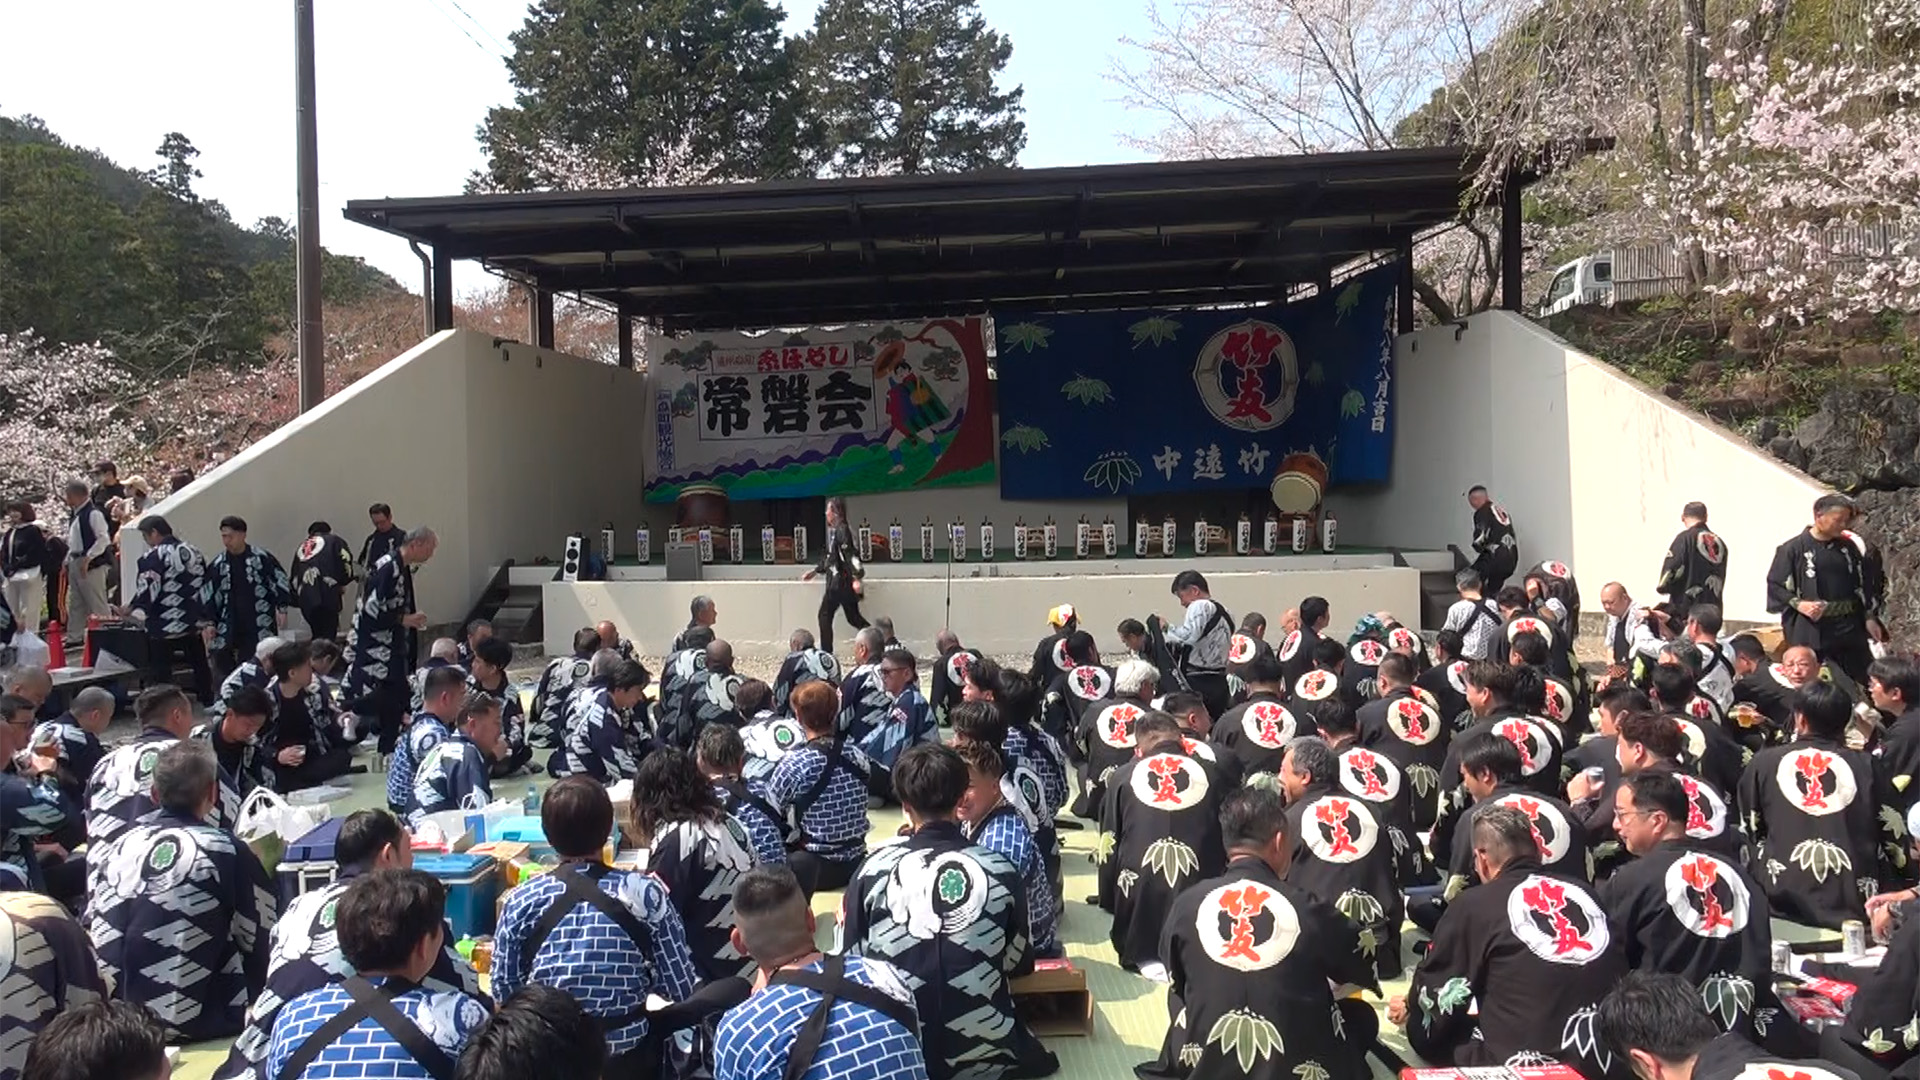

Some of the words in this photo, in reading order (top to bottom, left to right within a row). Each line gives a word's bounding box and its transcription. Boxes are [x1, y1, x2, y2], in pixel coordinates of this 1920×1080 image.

[703, 370, 873, 437] 常磐会
[1152, 441, 1321, 482] 中遠竹
